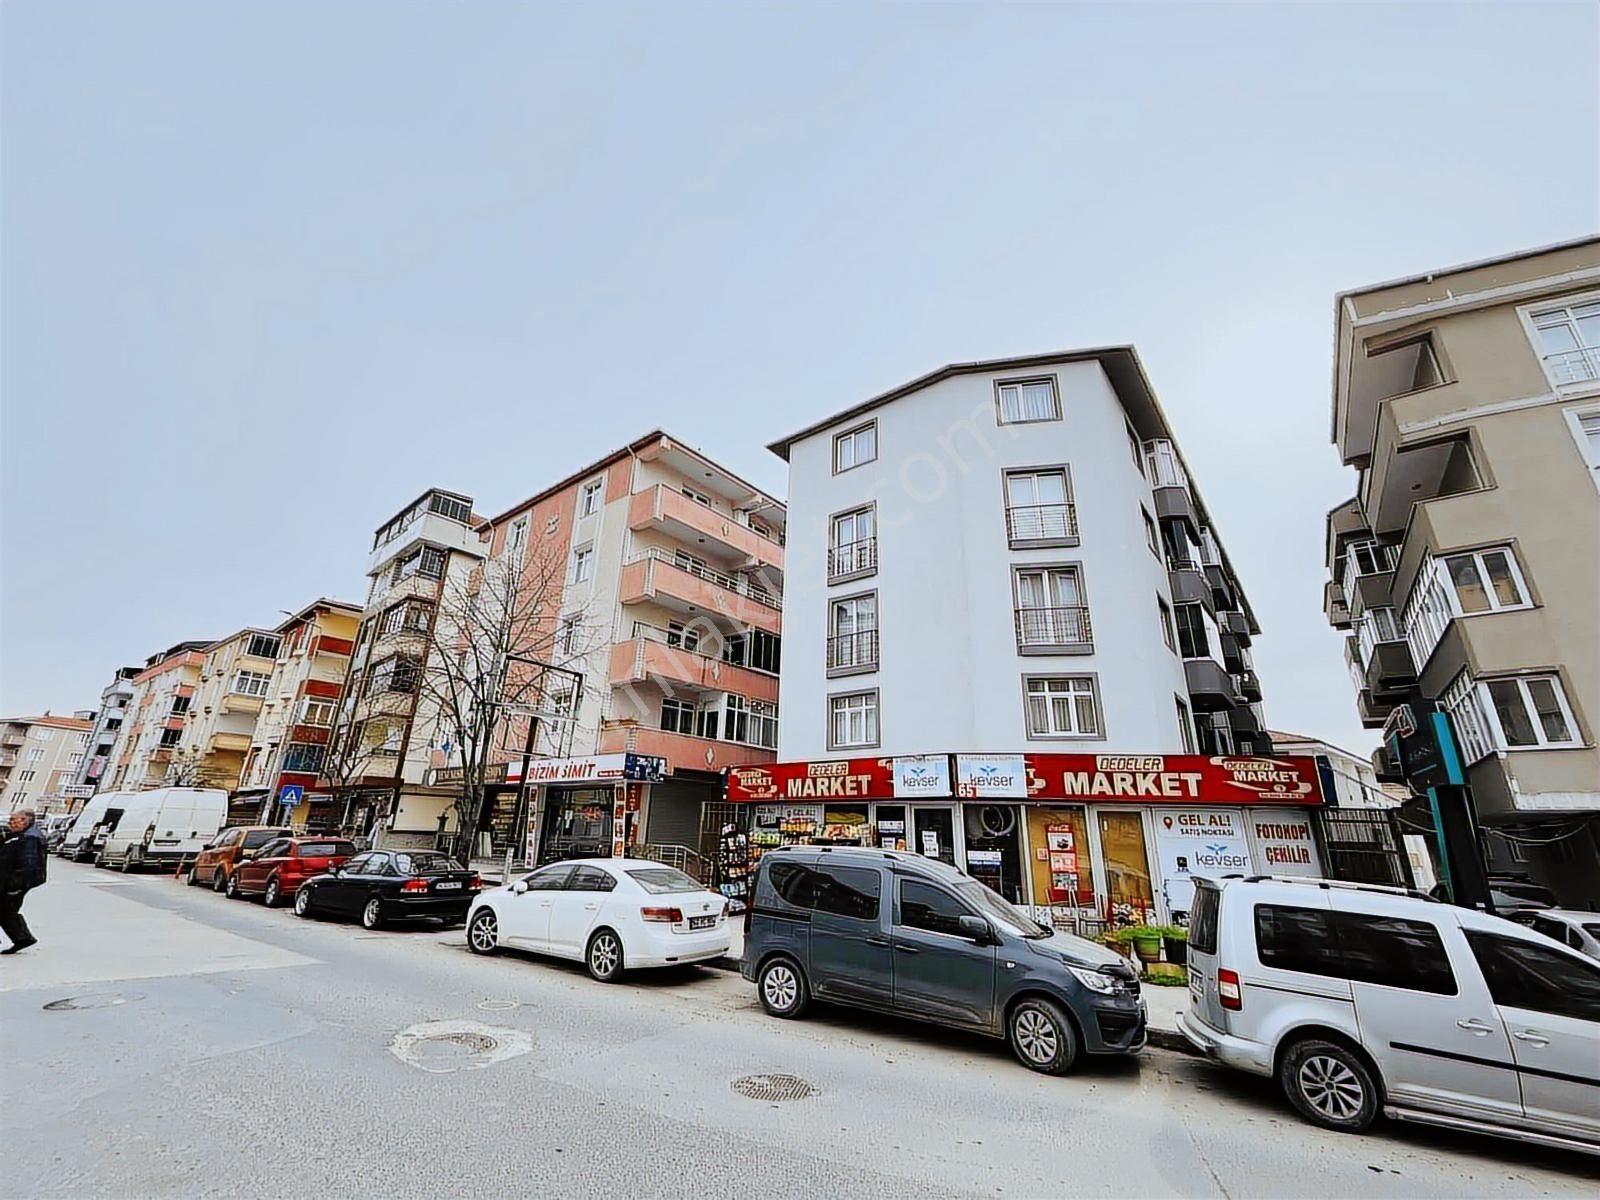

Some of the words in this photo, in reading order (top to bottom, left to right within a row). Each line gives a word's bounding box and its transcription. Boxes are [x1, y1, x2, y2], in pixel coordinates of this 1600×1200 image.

[529, 763, 559, 779] BİZİM
[1100, 758, 1161, 770] DEDELER
[903, 775, 938, 787] kevser
[970, 773, 1013, 786] kevser
[1234, 771, 1298, 782] MARKET
[788, 775, 871, 797] MARKET
[959, 784, 974, 797] 65
[1064, 773, 1202, 796] MARKET
[1178, 815, 1205, 826] GEL
[1209, 816, 1231, 827] AL!
[1256, 821, 1310, 840] FOTOKOPİ
[1196, 852, 1247, 867] kevser
[1266, 845, 1310, 865] ÇEKİLİR
